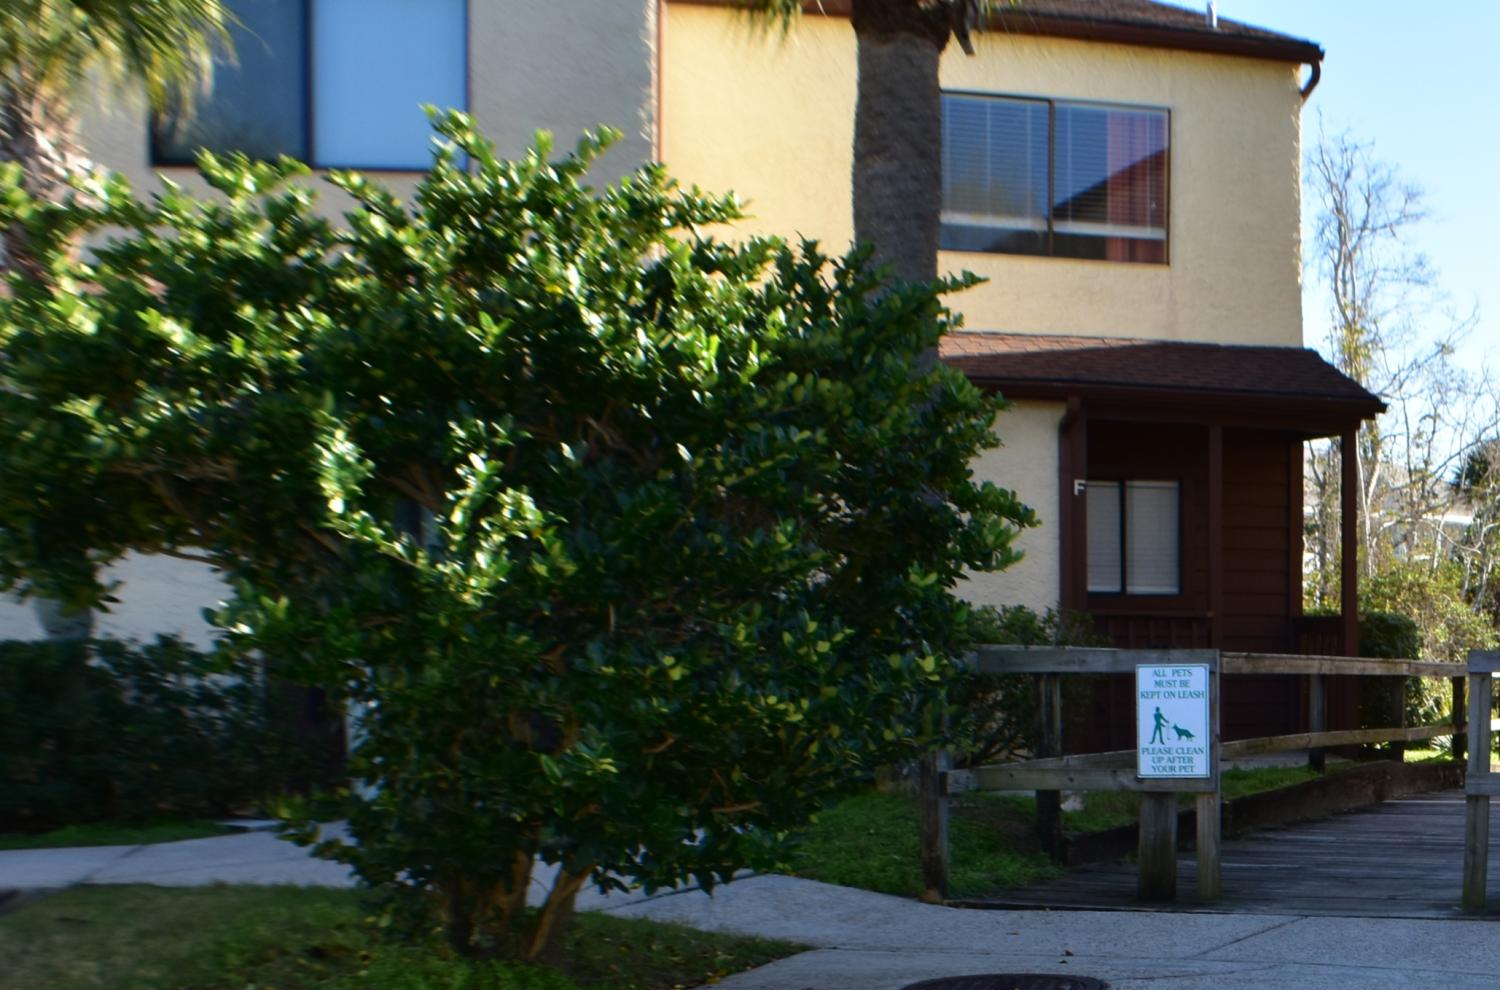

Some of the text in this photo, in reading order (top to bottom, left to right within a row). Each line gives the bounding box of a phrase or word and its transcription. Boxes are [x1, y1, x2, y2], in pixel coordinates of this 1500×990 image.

[1074, 480, 1086, 496] F
[1152, 669, 1192, 677] ALL PETS
[1141, 691, 1160, 699] KEPT
[1178, 690, 1204, 698] LEASH
